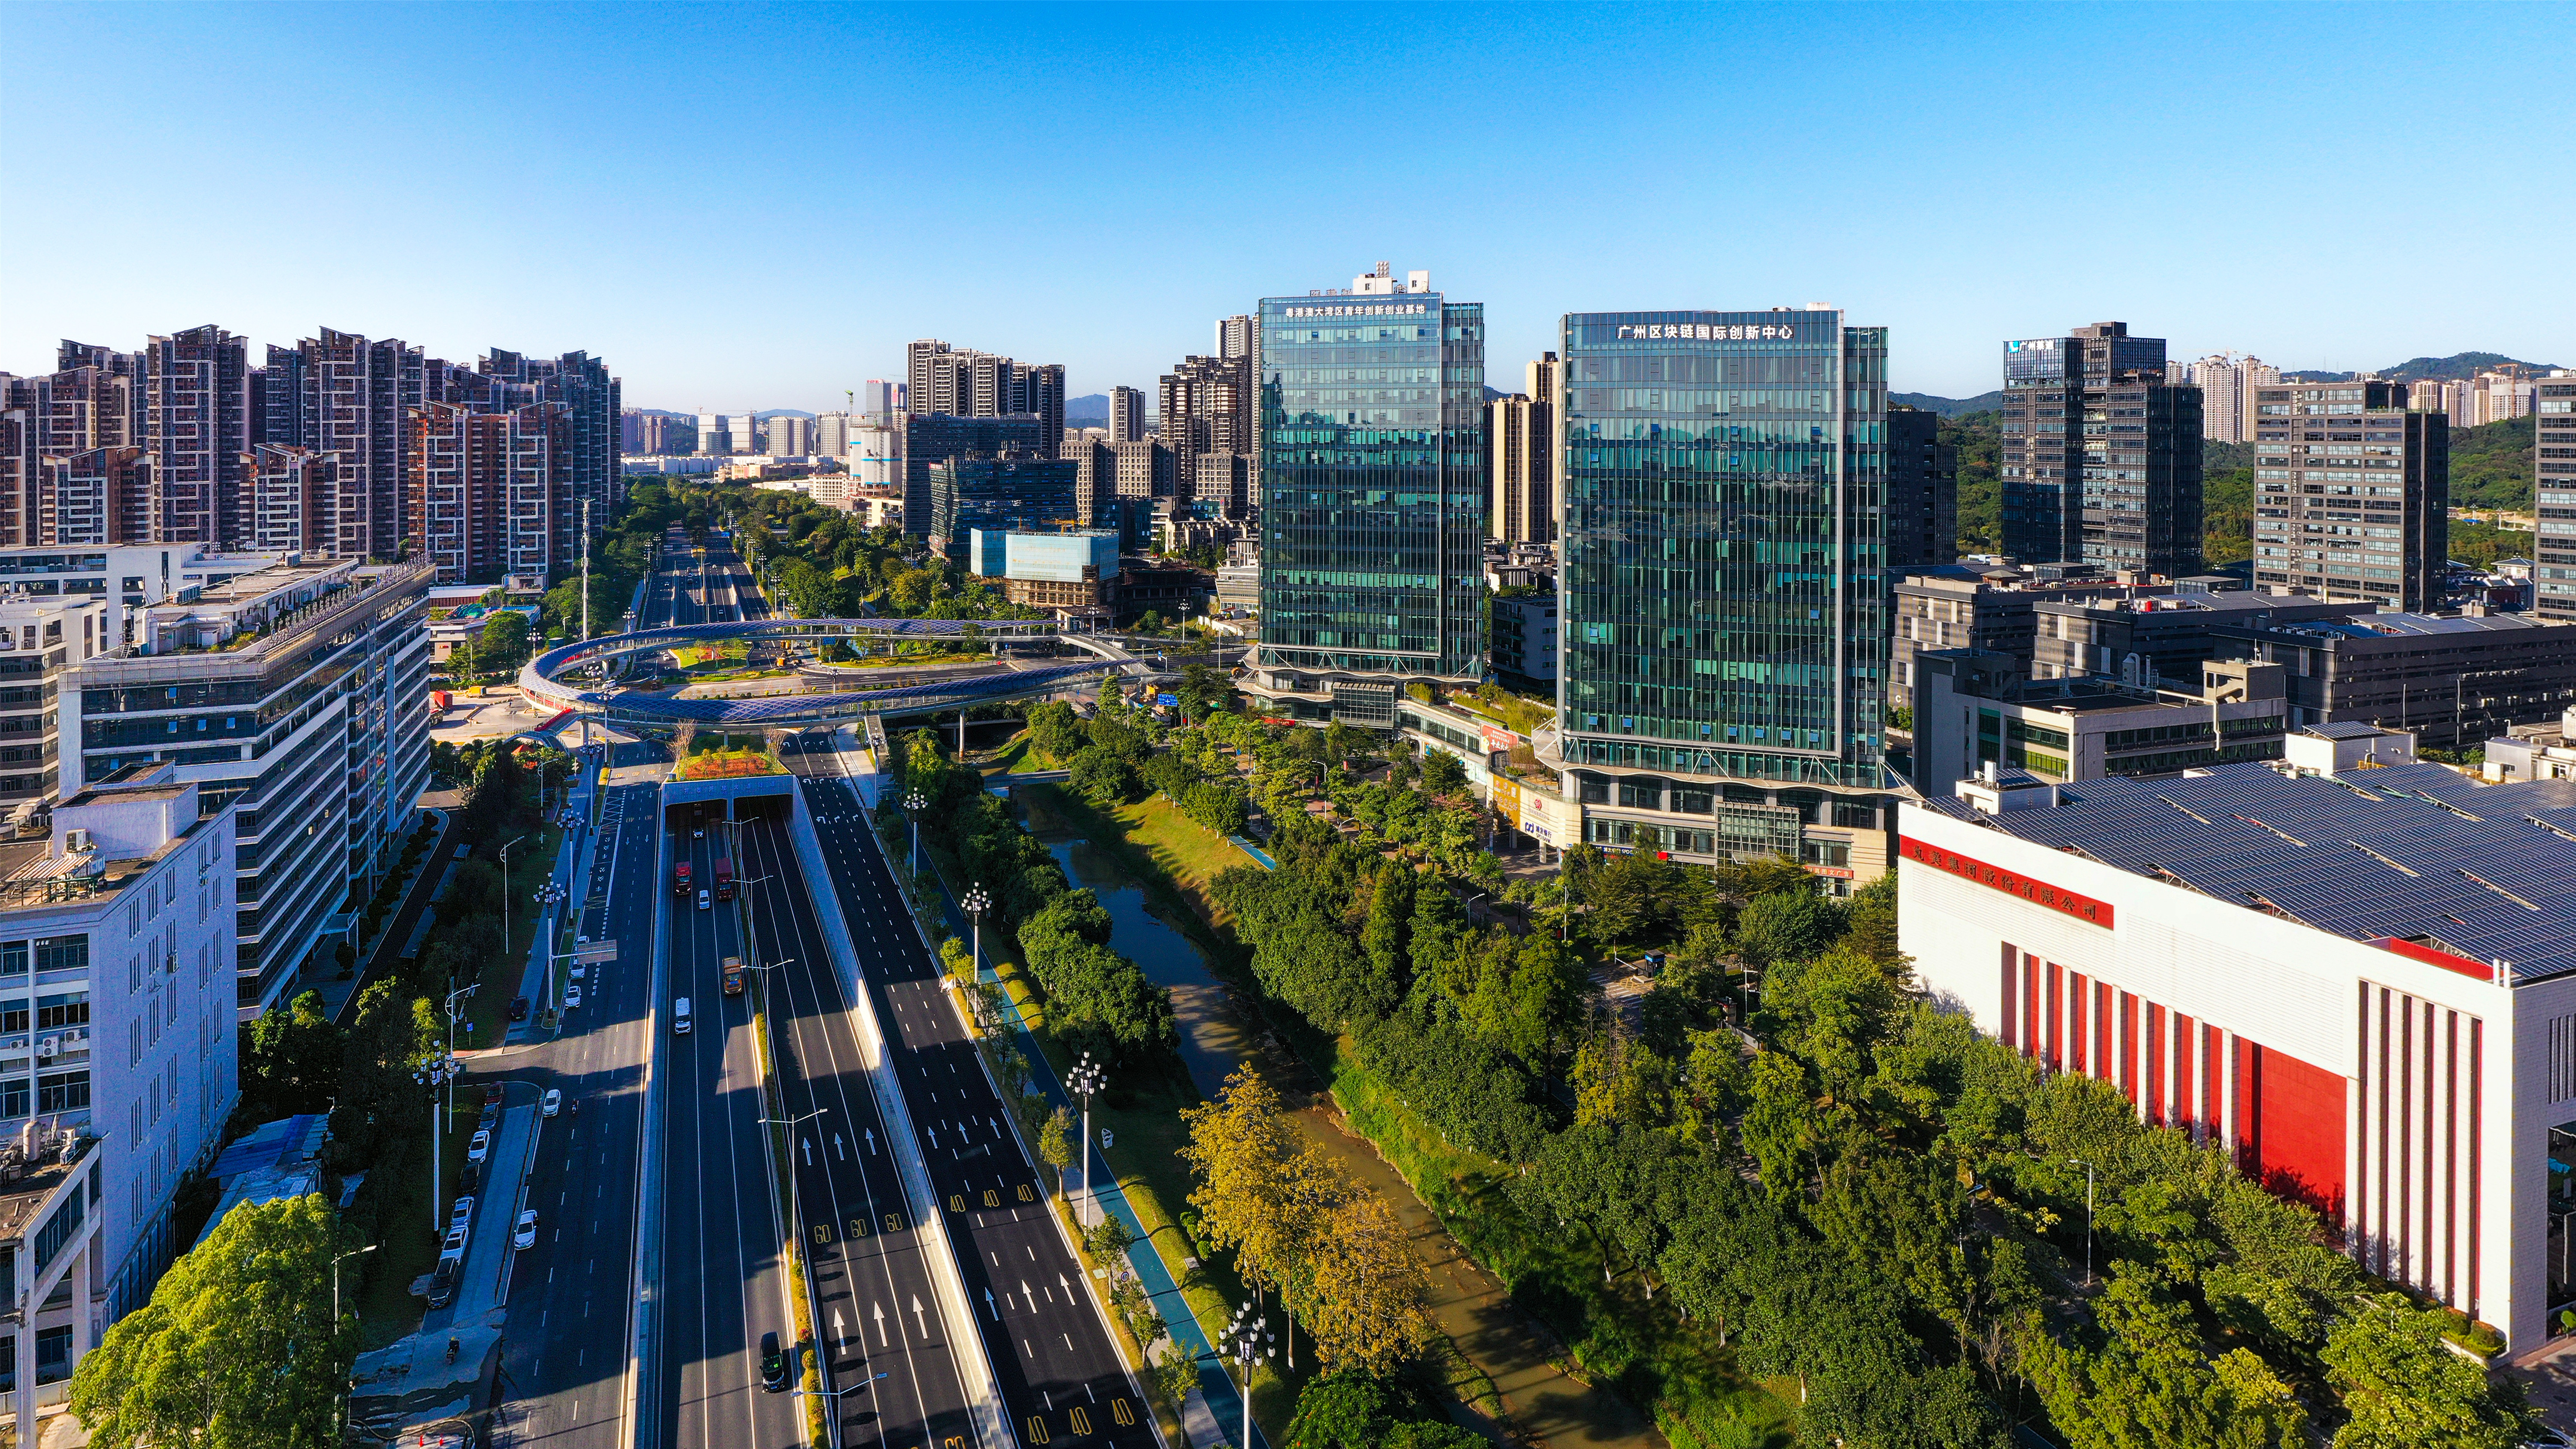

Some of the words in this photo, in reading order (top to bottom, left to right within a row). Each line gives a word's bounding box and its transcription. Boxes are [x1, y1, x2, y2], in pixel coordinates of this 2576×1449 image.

[1285, 304, 1425, 318] 粤港澳大湾区青年创新创业基地
[1617, 324, 1793, 341] 广州区块链国际创新中心
[950, 1194, 966, 1213] 40
[983, 1189, 999, 1207] 40
[1017, 1184, 1034, 1202] 40
[814, 1224, 831, 1244] 60
[850, 1218, 867, 1238] 60
[885, 1213, 903, 1232] 60
[1027, 1416, 1050, 1446] 40
[1068, 1406, 1092, 1437] 40
[1111, 1397, 1135, 1427] 40
